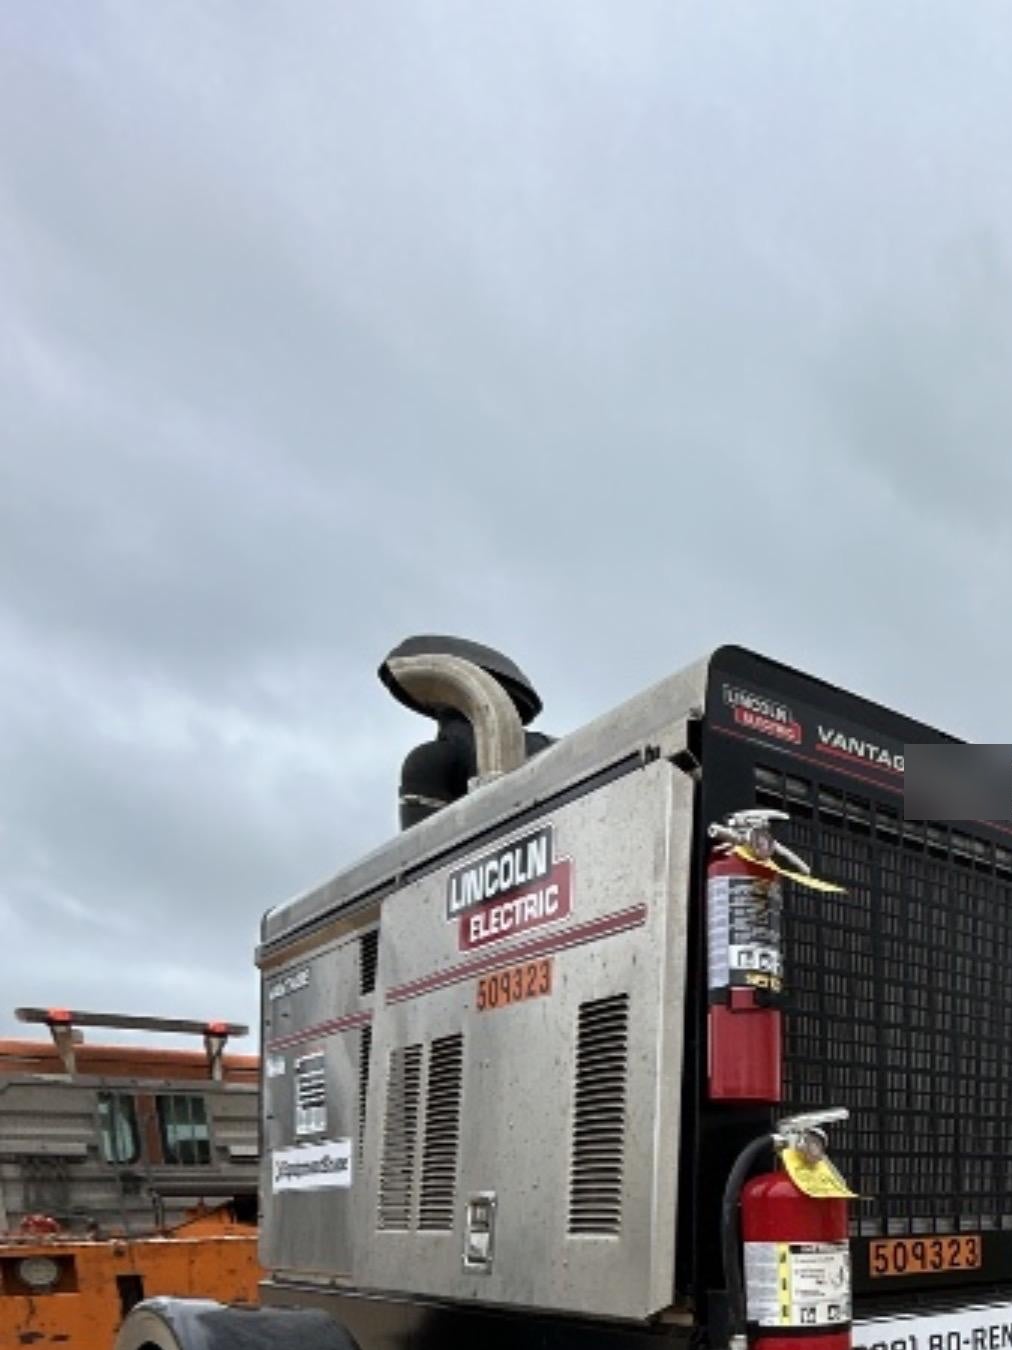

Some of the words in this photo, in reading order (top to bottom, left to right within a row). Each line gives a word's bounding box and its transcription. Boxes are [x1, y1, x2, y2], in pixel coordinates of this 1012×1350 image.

[817, 725, 905, 772] VANTAG
[451, 835, 547, 912] LINCOLN
[469, 884, 559, 943] ELECTRIC
[476, 961, 551, 1010] 509323
[875, 1238, 977, 1273] 509323
